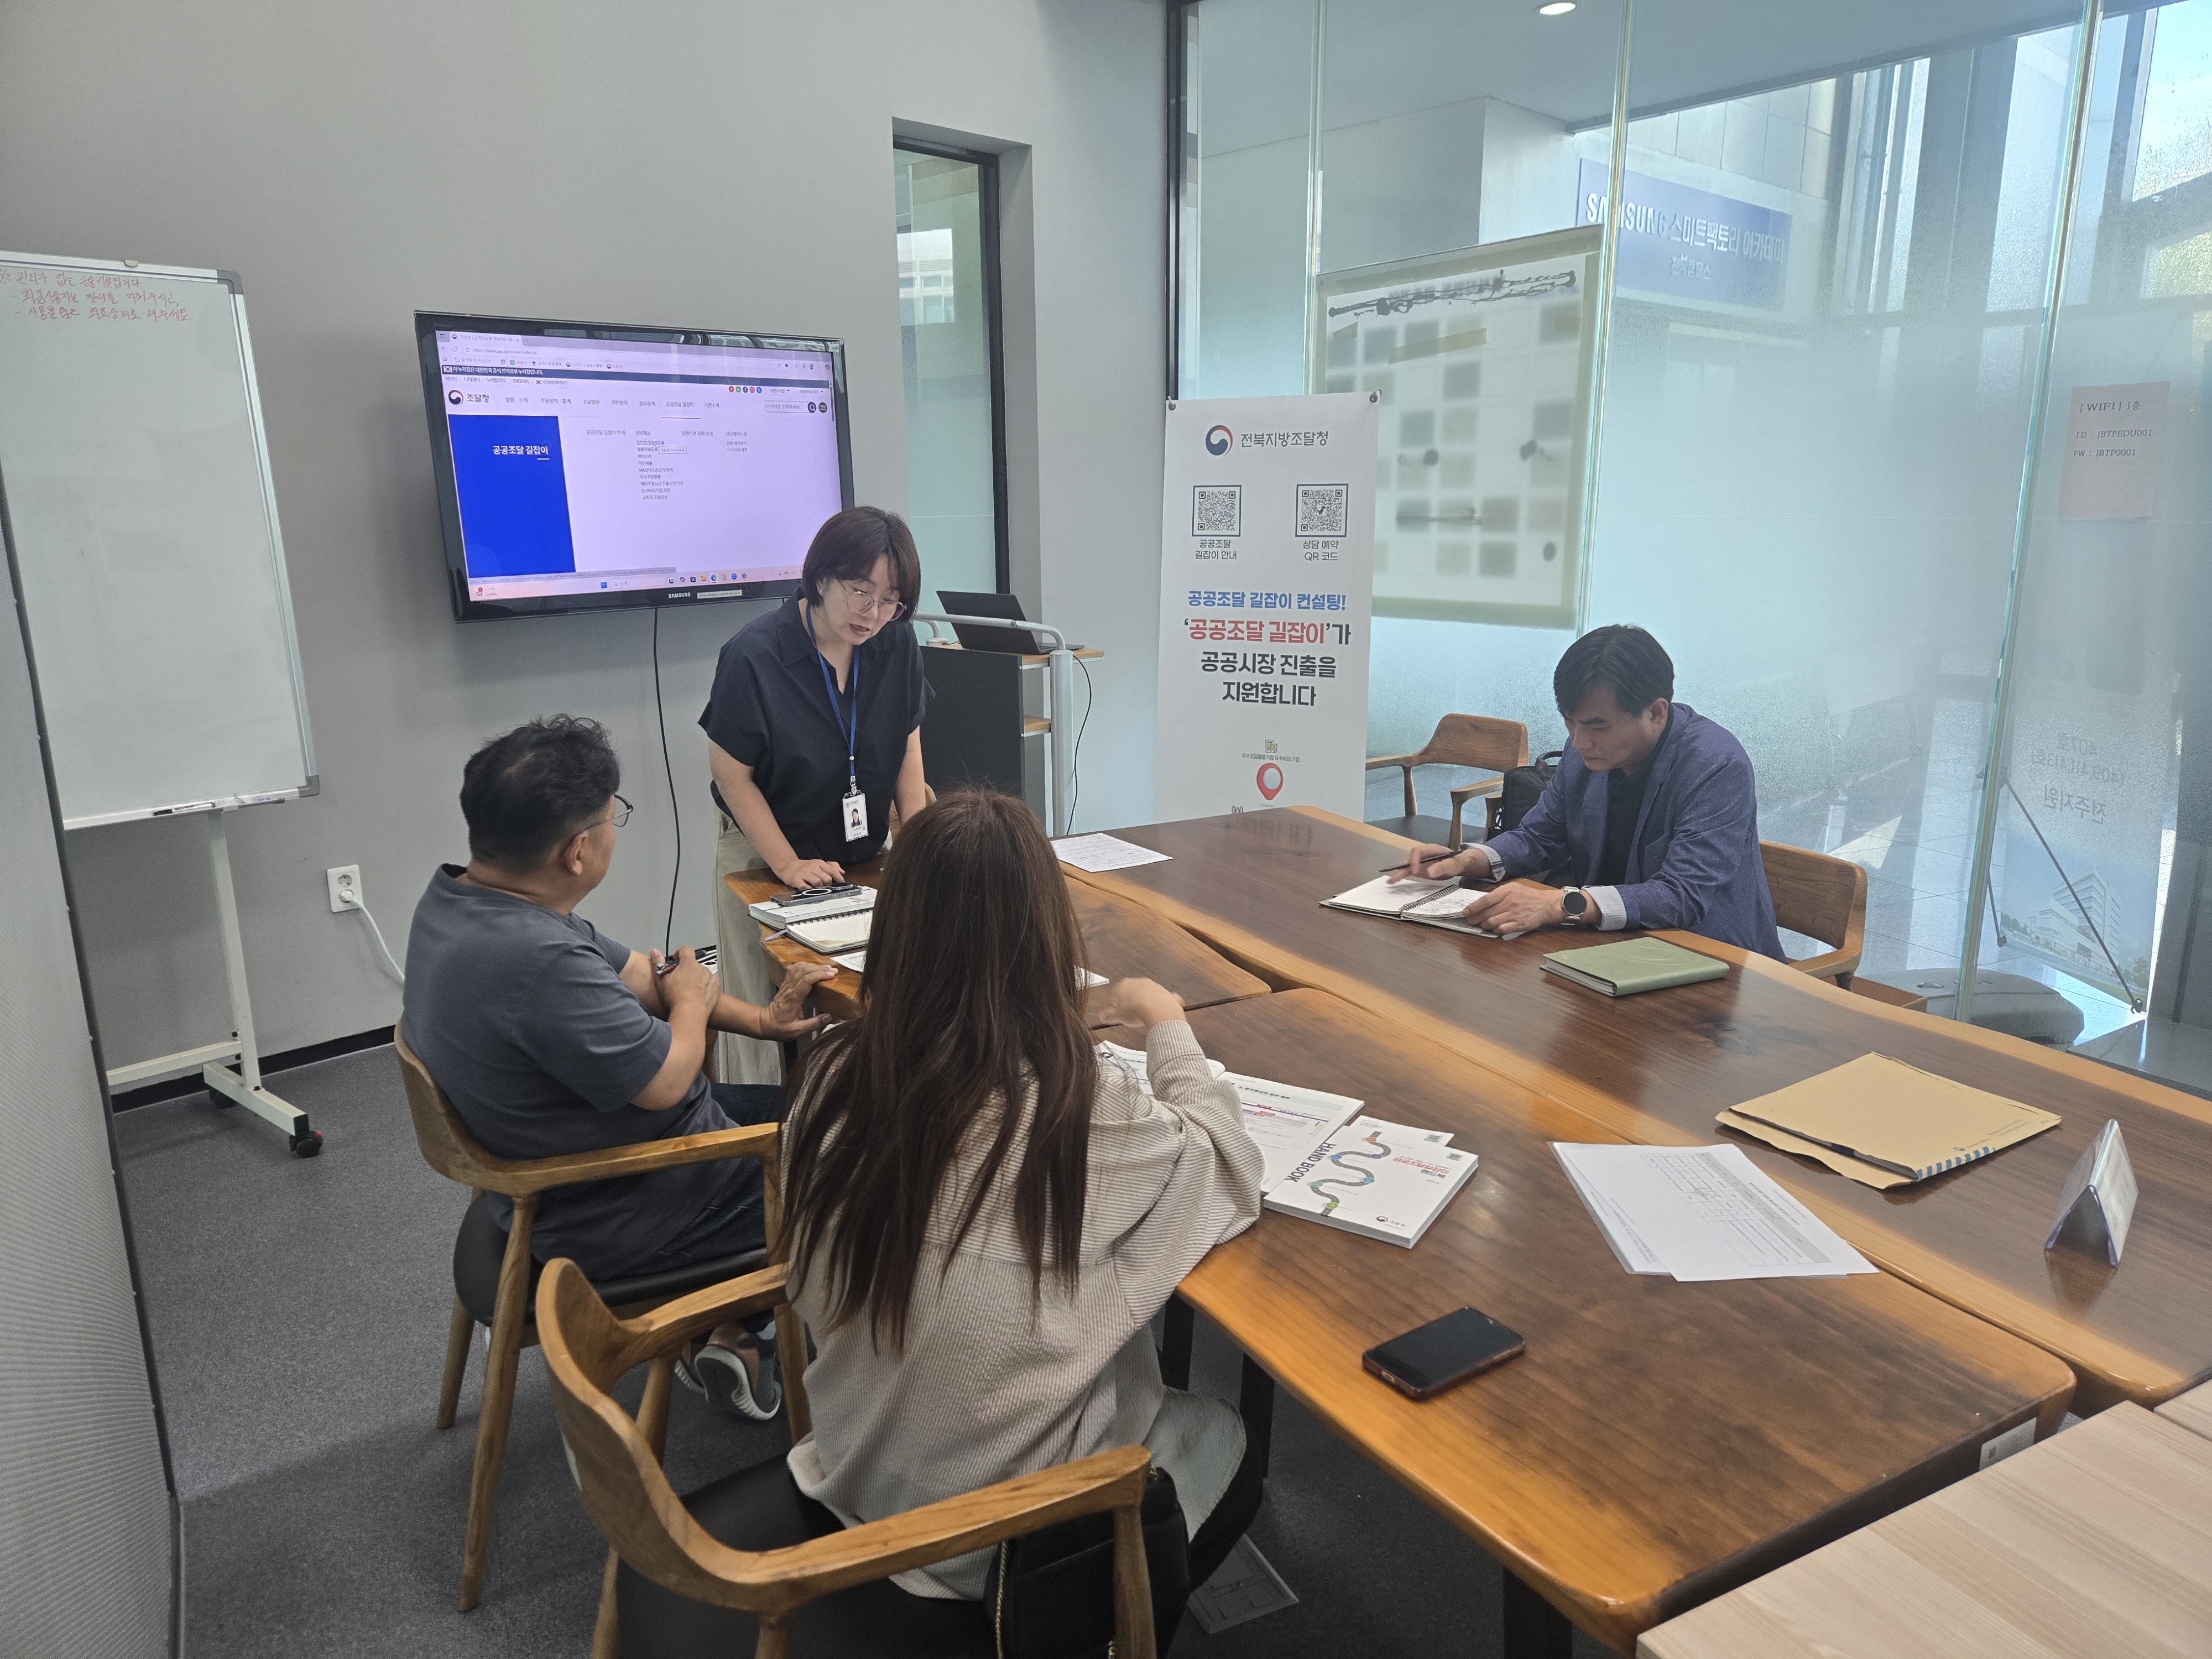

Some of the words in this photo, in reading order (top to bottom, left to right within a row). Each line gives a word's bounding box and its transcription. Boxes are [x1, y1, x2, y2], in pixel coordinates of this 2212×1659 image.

[1668, 213, 1741, 256] 스마트팩토리
[1743, 230, 1785, 265] 아카데미
[16, 270, 49, 286] 관리가
[467, 394, 489, 403] 조달청
[1240, 431, 1328, 448] 전북지방조달청
[2096, 429, 2153, 439] JBTPEDU001
[492, 446, 524, 455] 공공조달
[525, 446, 549, 455] 길잡이
[2095, 448, 2136, 458] JBTP0001
[1199, 539, 1232, 549] 공공조달
[1302, 540, 1320, 550] 상담
[1321, 540, 1339, 550] 예약
[1195, 550, 1219, 560] 길잡이
[1220, 550, 1237, 560] 안내
[1304, 552, 1319, 562] QR
[1321, 552, 1338, 561] 코드
[1188, 590, 1246, 608] 공공조달
[1250, 592, 1292, 609] 길잡이
[1297, 593, 1346, 611] 컨설팅!
[1201, 651, 1276, 675] 공공시장
[1280, 654, 1337, 679] 진출을
[1222, 681, 1317, 706] 지원합니다
[1308, 1142, 1337, 1162] HAND
[1284, 1162, 1316, 1182] BOOK
